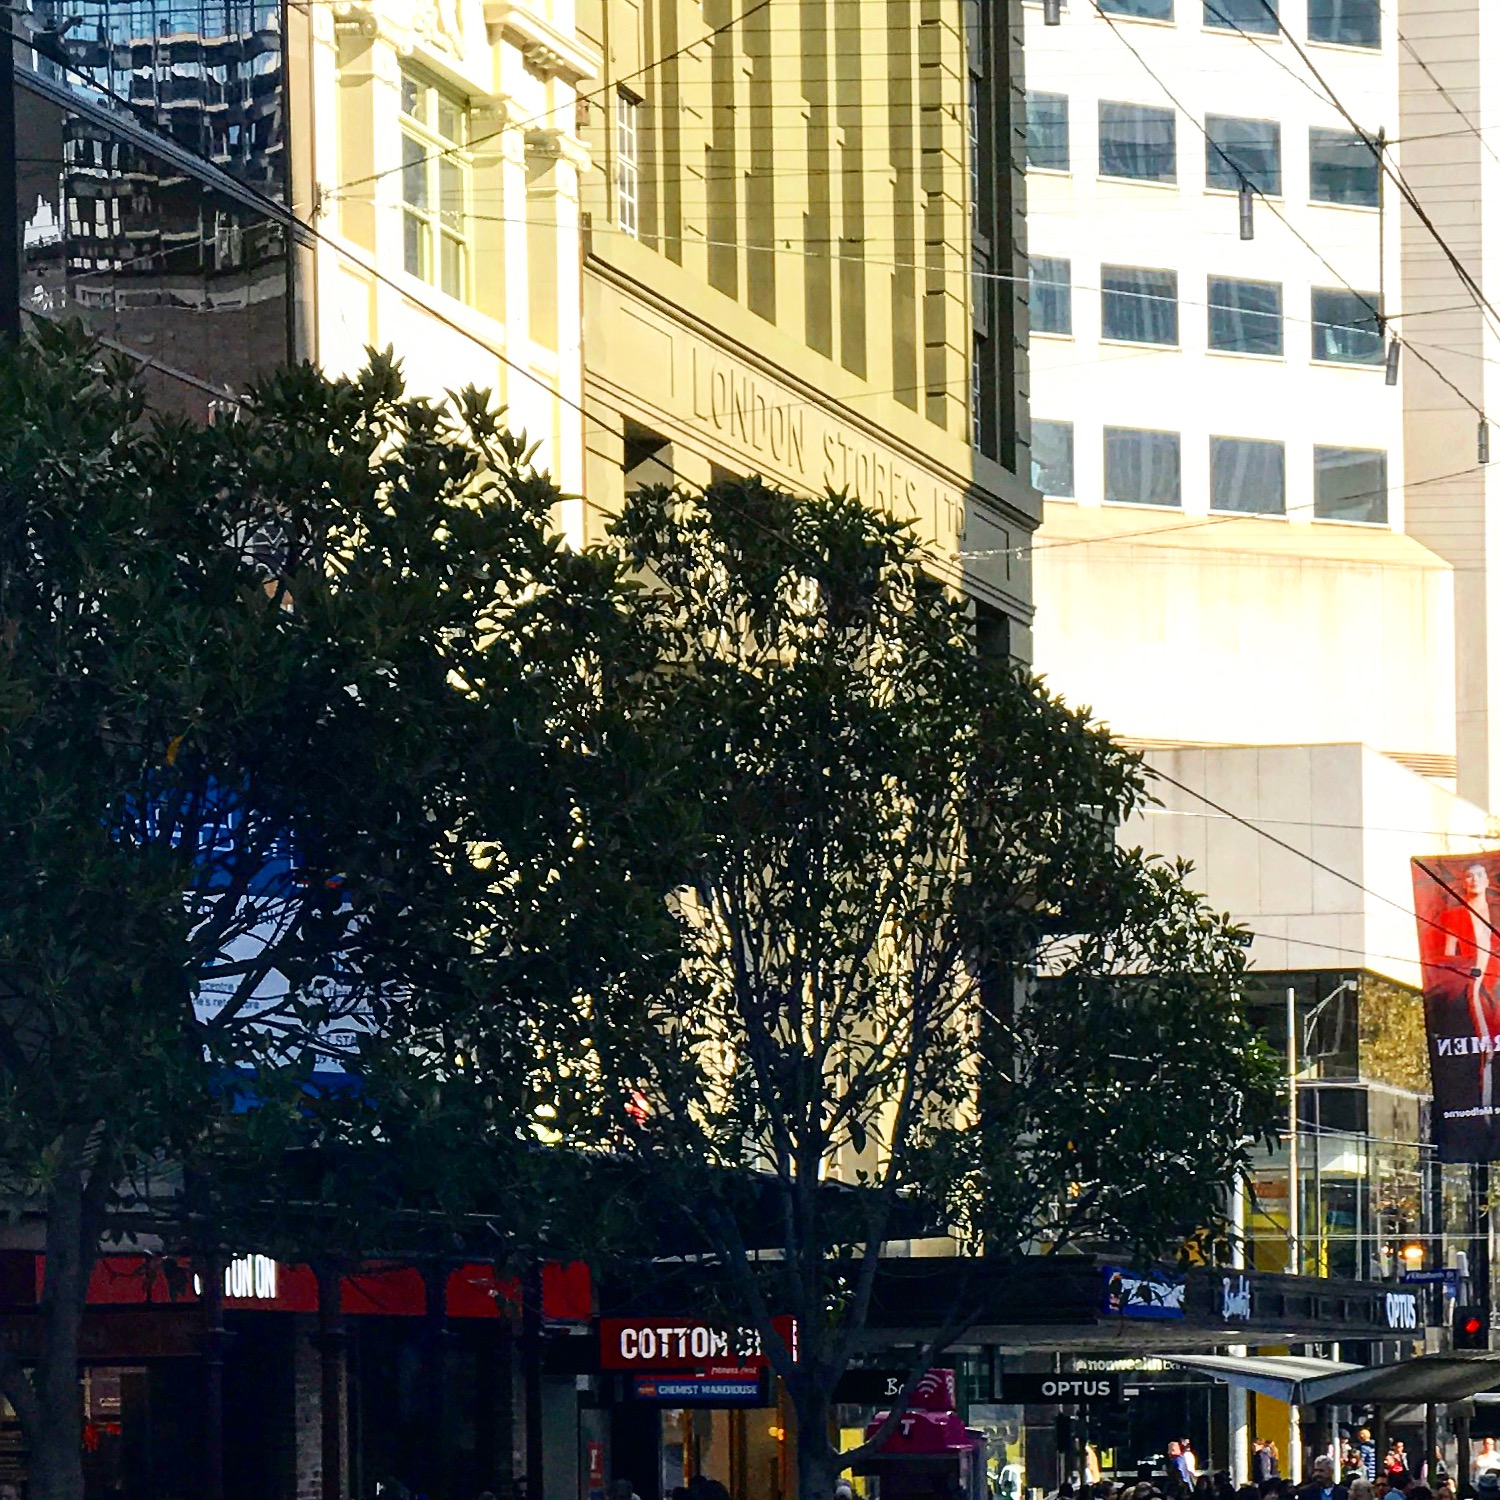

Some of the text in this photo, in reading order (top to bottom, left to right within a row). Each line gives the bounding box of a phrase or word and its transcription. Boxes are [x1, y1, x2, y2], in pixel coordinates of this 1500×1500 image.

[691, 345, 805, 474] LONDON
[822, 427, 918, 521] STORES
[1385, 1292, 1416, 1329] OPTUS
[620, 1326, 728, 1360] COTTON
[658, 1385, 699, 1396] CHEMIST
[701, 1385, 758, 1395] WAREHOUSE
[1041, 1379, 1111, 1397] OPTUS
